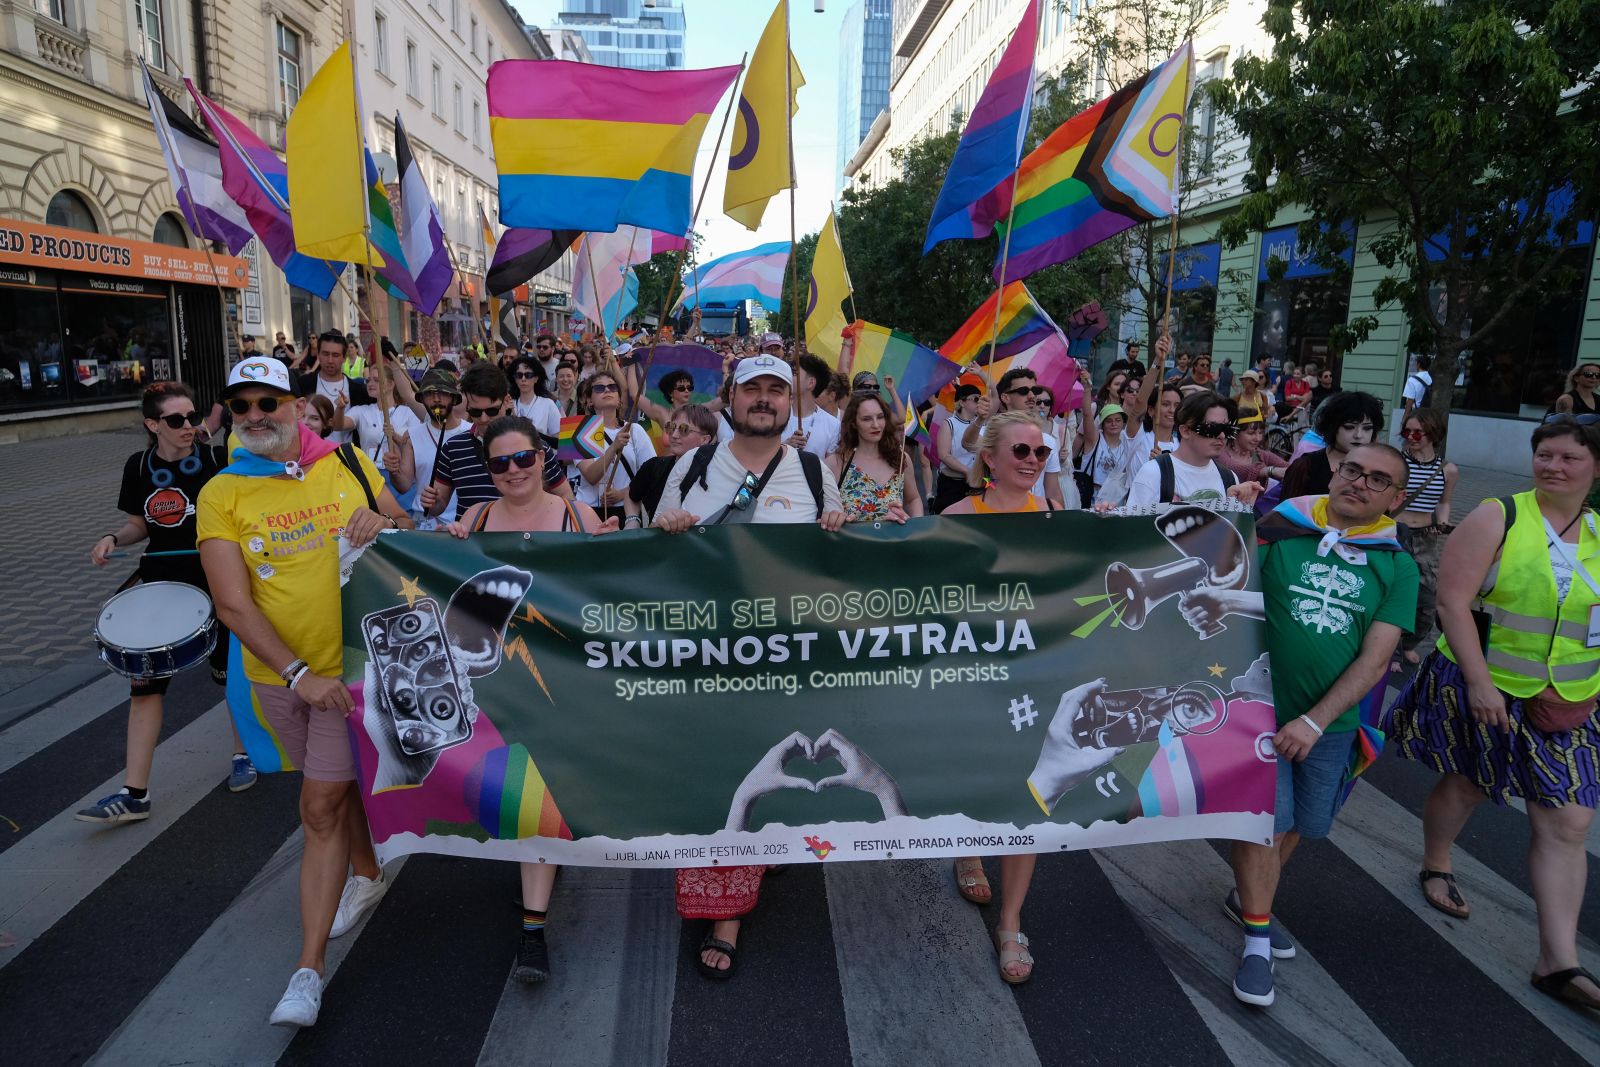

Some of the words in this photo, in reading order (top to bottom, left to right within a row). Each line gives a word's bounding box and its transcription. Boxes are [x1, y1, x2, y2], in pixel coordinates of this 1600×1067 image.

[29, 233, 131, 266] PRODUCTS
[144, 255, 162, 266] BUY
[168, 258, 188, 270] SELL
[193, 262, 209, 273] BUY
[210, 265, 229, 275] ACK
[89, 279, 109, 289] Vedno
[154, 500, 176, 508] DRUM
[266, 502, 341, 530] EQUALITY
[270, 522, 315, 543] FROM
[319, 515, 340, 527] THE
[273, 534, 326, 557] HEART
[580, 600, 718, 634] SISTEM
[732, 598, 777, 629] SE
[791, 582, 1035, 625] POSODABLJA
[584, 632, 819, 669] SKUPNOST
[838, 619, 1036, 659] VZTRAJA
[615, 677, 687, 700] System
[694, 671, 803, 696] rebooting.
[809, 666, 921, 690] Community
[930, 663, 1009, 690] persists
[605, 848, 671, 862] LJUBLJANA
[674, 847, 706, 859] PRIDE
[709, 845, 760, 858] FESTIVAL
[763, 844, 789, 856] 2025
[853, 839, 905, 852] FESTIVAL
[908, 837, 953, 849] PARADA
[956, 836, 1005, 848] PONOSA
[1008, 835, 1035, 847] 2025
